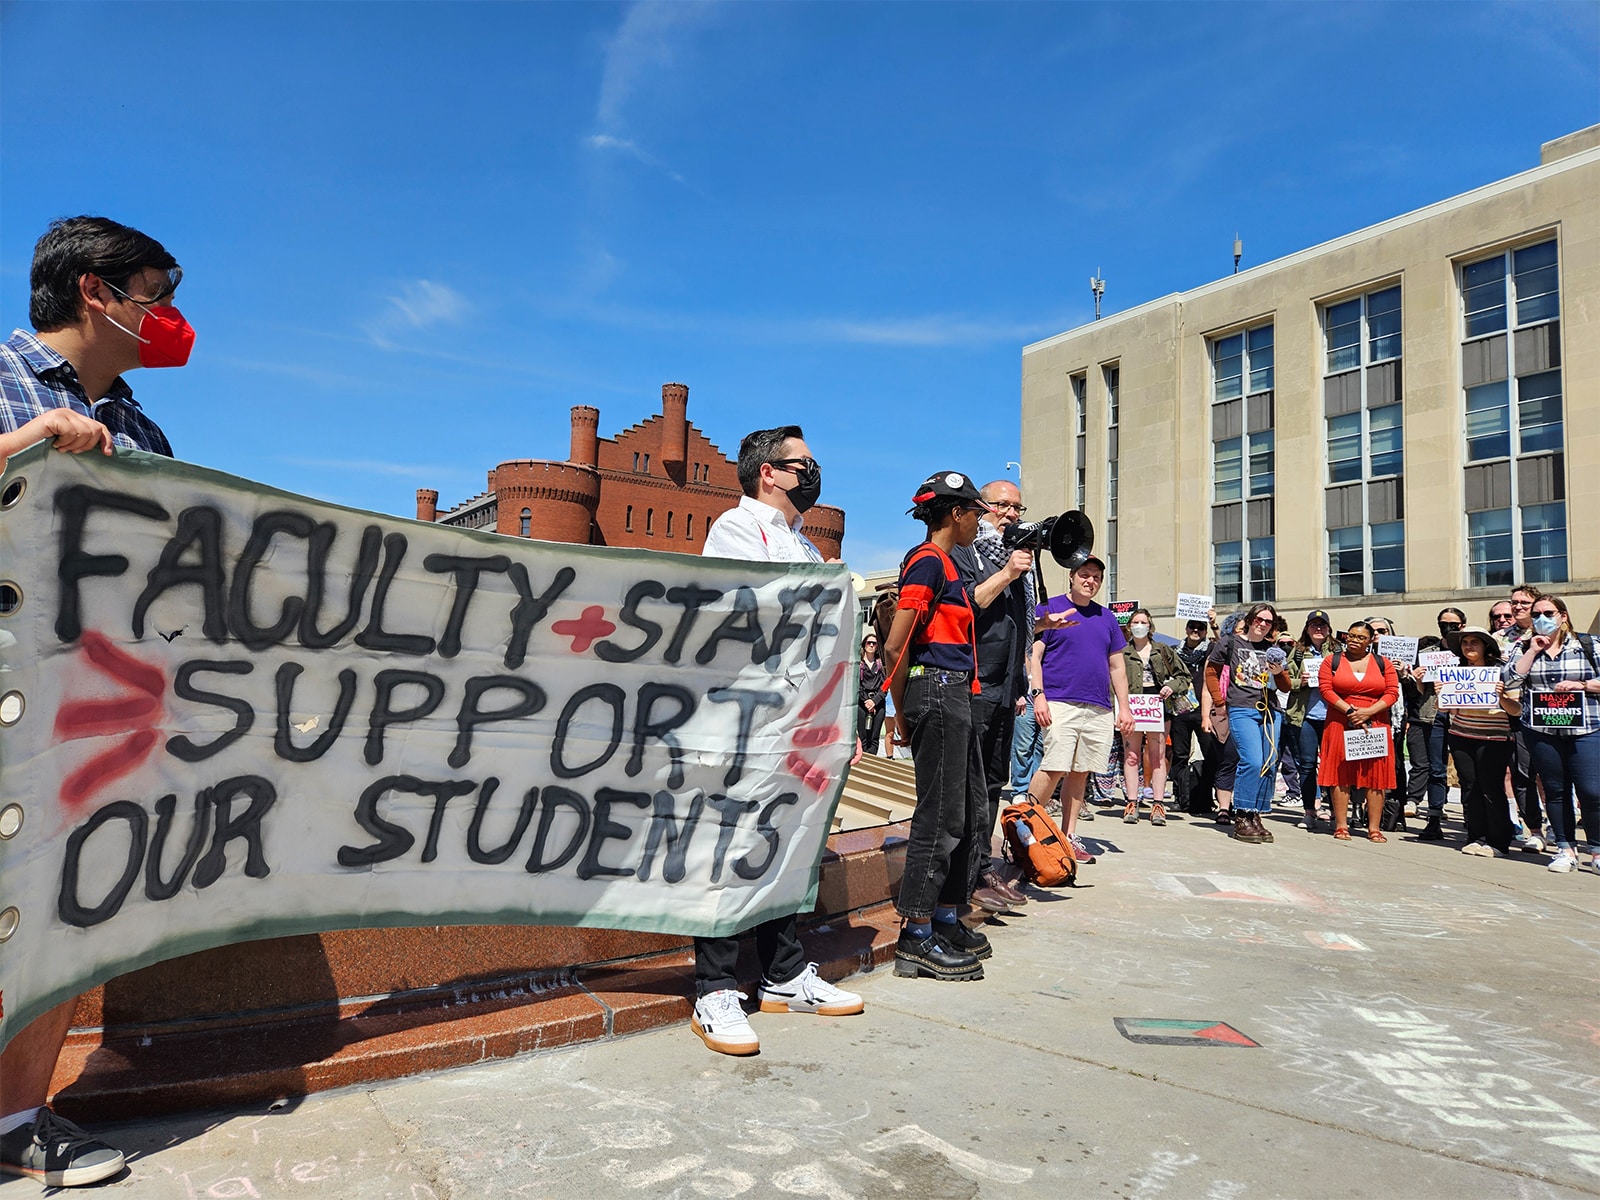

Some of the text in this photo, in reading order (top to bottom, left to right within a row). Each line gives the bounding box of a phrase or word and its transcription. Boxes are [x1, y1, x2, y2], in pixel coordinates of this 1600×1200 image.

[53, 484, 577, 669] FACULTY
[594, 579, 842, 673] STAFF
[1439, 668, 1477, 683] HANDS
[1479, 667, 1499, 682] OFF
[1455, 682, 1477, 691] OUR
[1441, 691, 1498, 705] STUDENTS
[1540, 693, 1575, 702] HANDS
[1533, 707, 1582, 715] STUDENTS
[165, 659, 784, 789] SUPPORT
[1347, 733, 1384, 741] HOLOCAUST
[57, 773, 798, 928] OUR STUDENTS
